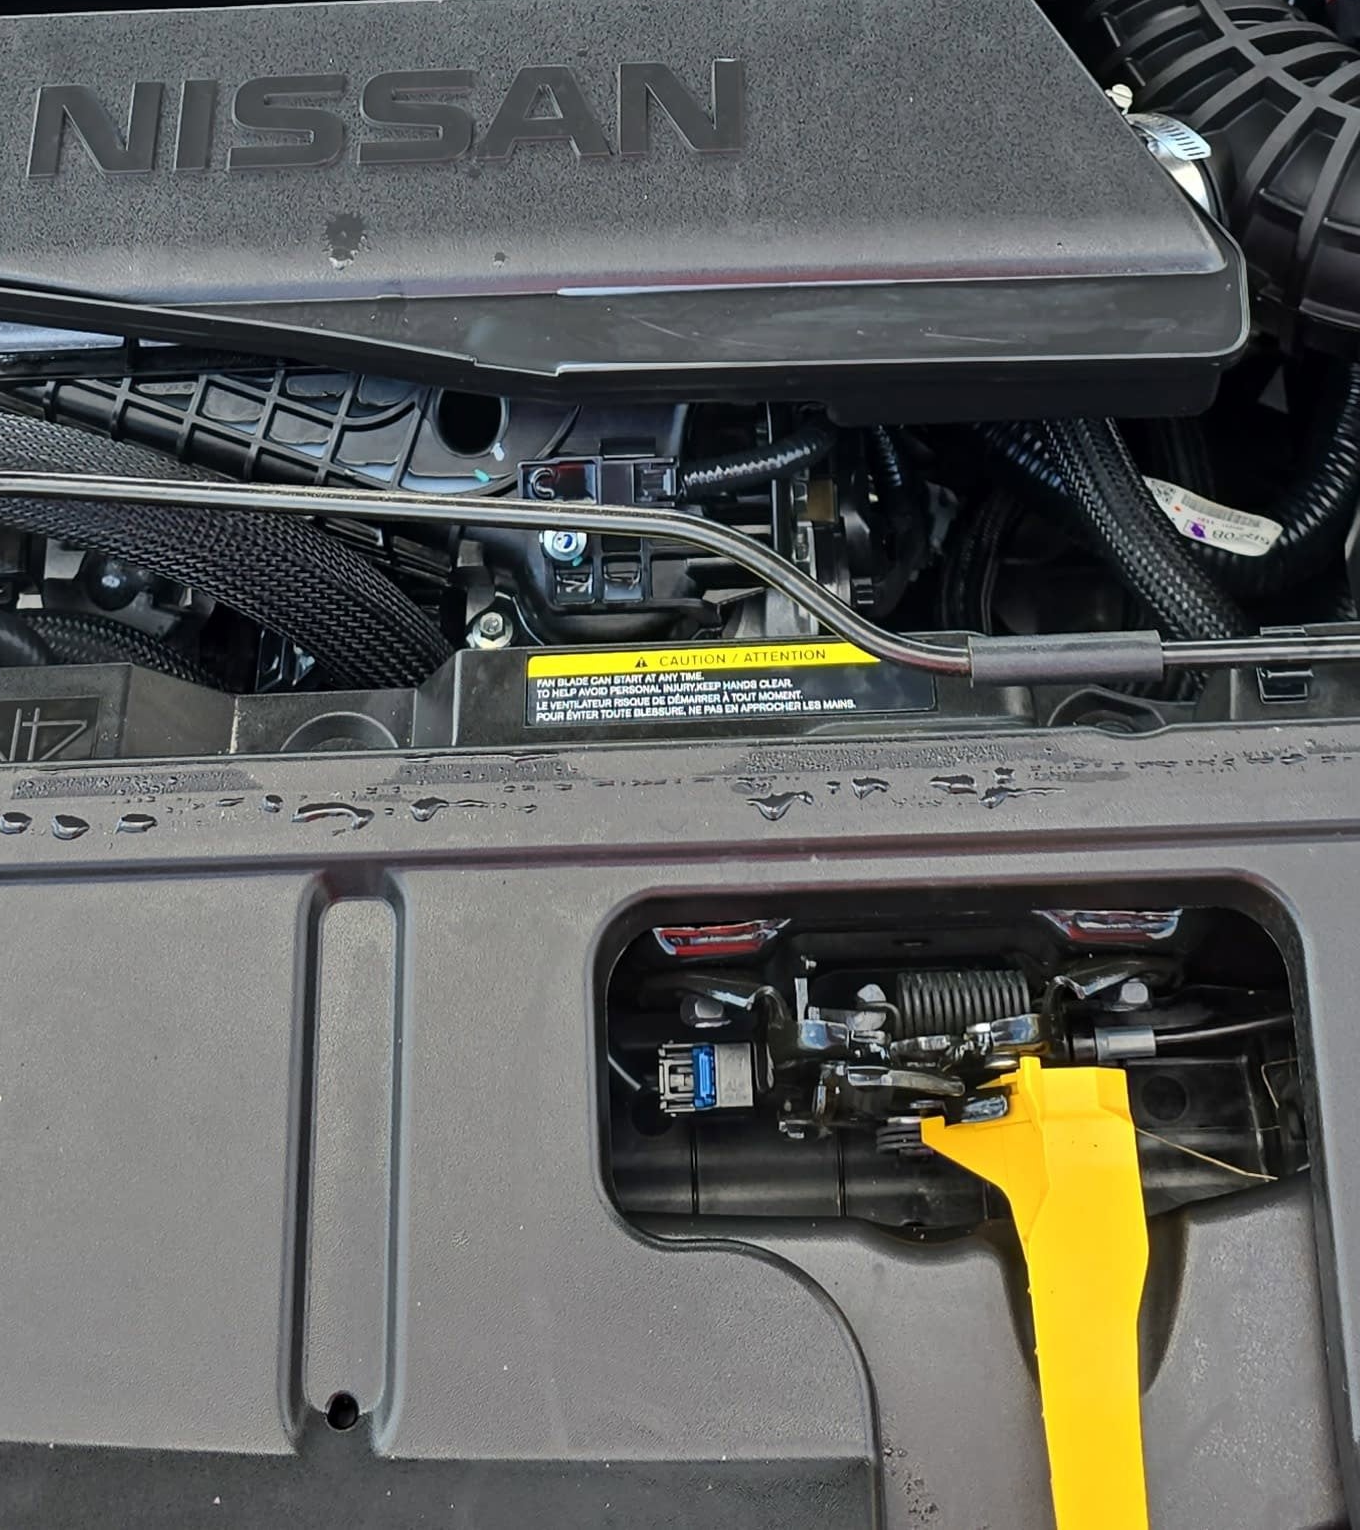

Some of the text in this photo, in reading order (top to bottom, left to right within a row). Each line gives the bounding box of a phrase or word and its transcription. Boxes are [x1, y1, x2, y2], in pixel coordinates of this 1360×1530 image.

[26, 59, 742, 176] NISSAN
[659, 653, 726, 667] CAUTION
[744, 648, 826, 663] ATTENTION
[536, 670, 705, 689] FAN BLADE CAN START AT ANY TIME.
[536, 689, 550, 699] TO
[551, 687, 577, 699] HELP
[578, 686, 608, 697] AVOID
[609, 684, 662, 696] PERSONAL
[723, 679, 757, 691] HANDS
[759, 678, 793, 689] CLEAR.
[536, 700, 548, 711] LE
[549, 698, 612, 711] VENTILATEUR
[613, 696, 651, 708] RISQUE
[652, 695, 665, 706] DE
[667, 692, 720, 706] DÉMARRER
[731, 692, 756, 703] TOUT
[758, 690, 803, 701] MOMENT.
[536, 710, 565, 722] POUR
[566, 707, 599, 720] ÉVITER
[601, 708, 632, 719] TOUTE
[688, 704, 702, 715] NE
[704, 703, 723, 714] PAS
[725, 703, 738, 714] EN
[740, 700, 801, 713] APPROCHER
[802, 699, 821, 710] LES
